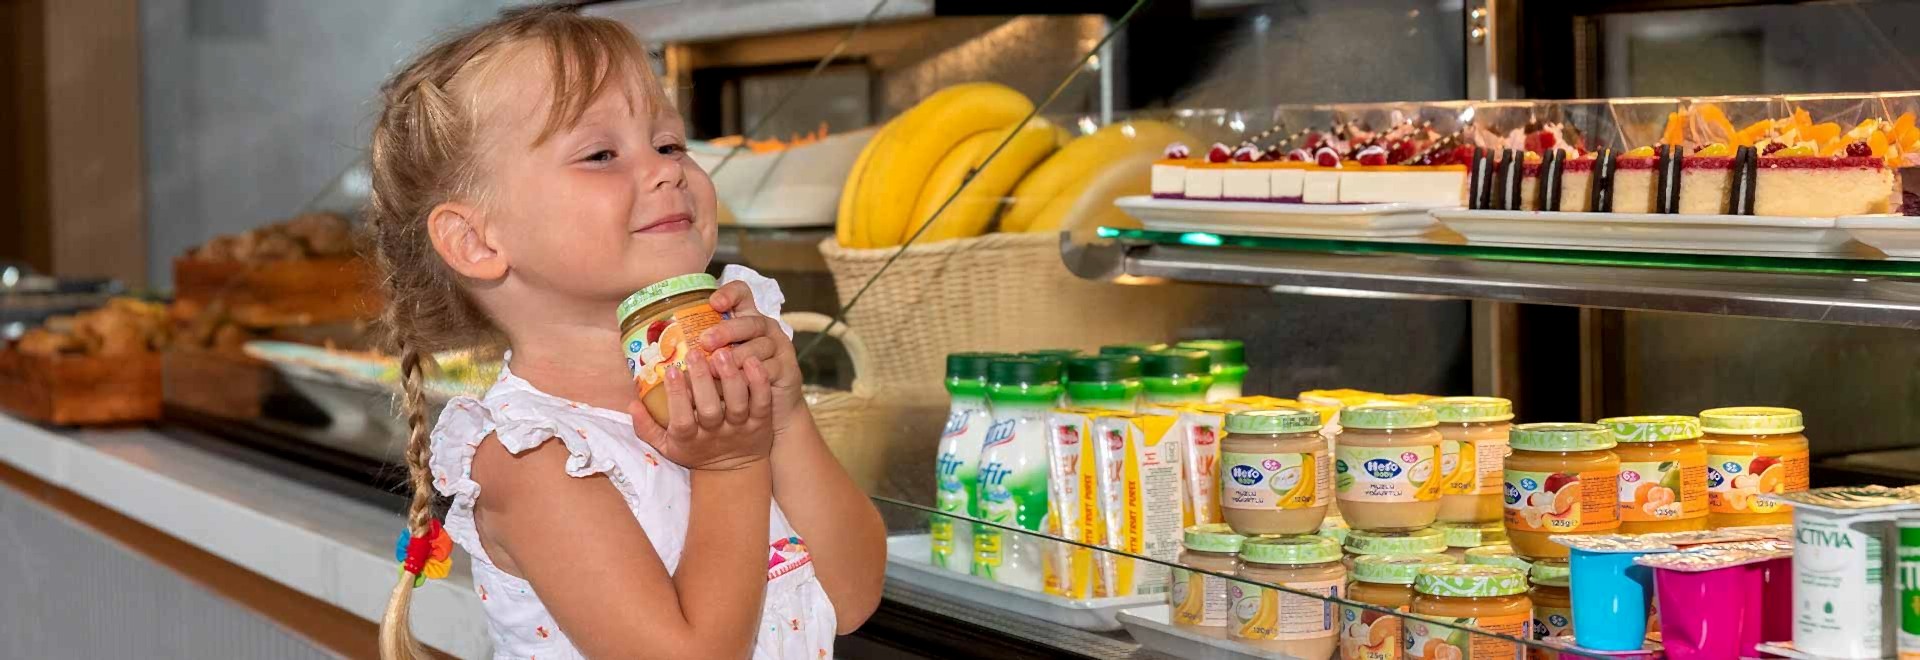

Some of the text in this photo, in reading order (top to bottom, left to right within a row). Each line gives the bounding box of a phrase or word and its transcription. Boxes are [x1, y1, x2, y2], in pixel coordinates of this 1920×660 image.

[1367, 461, 1398, 472] Hero
[1233, 467, 1259, 478] Hero
[1551, 520, 1571, 528] 125g
